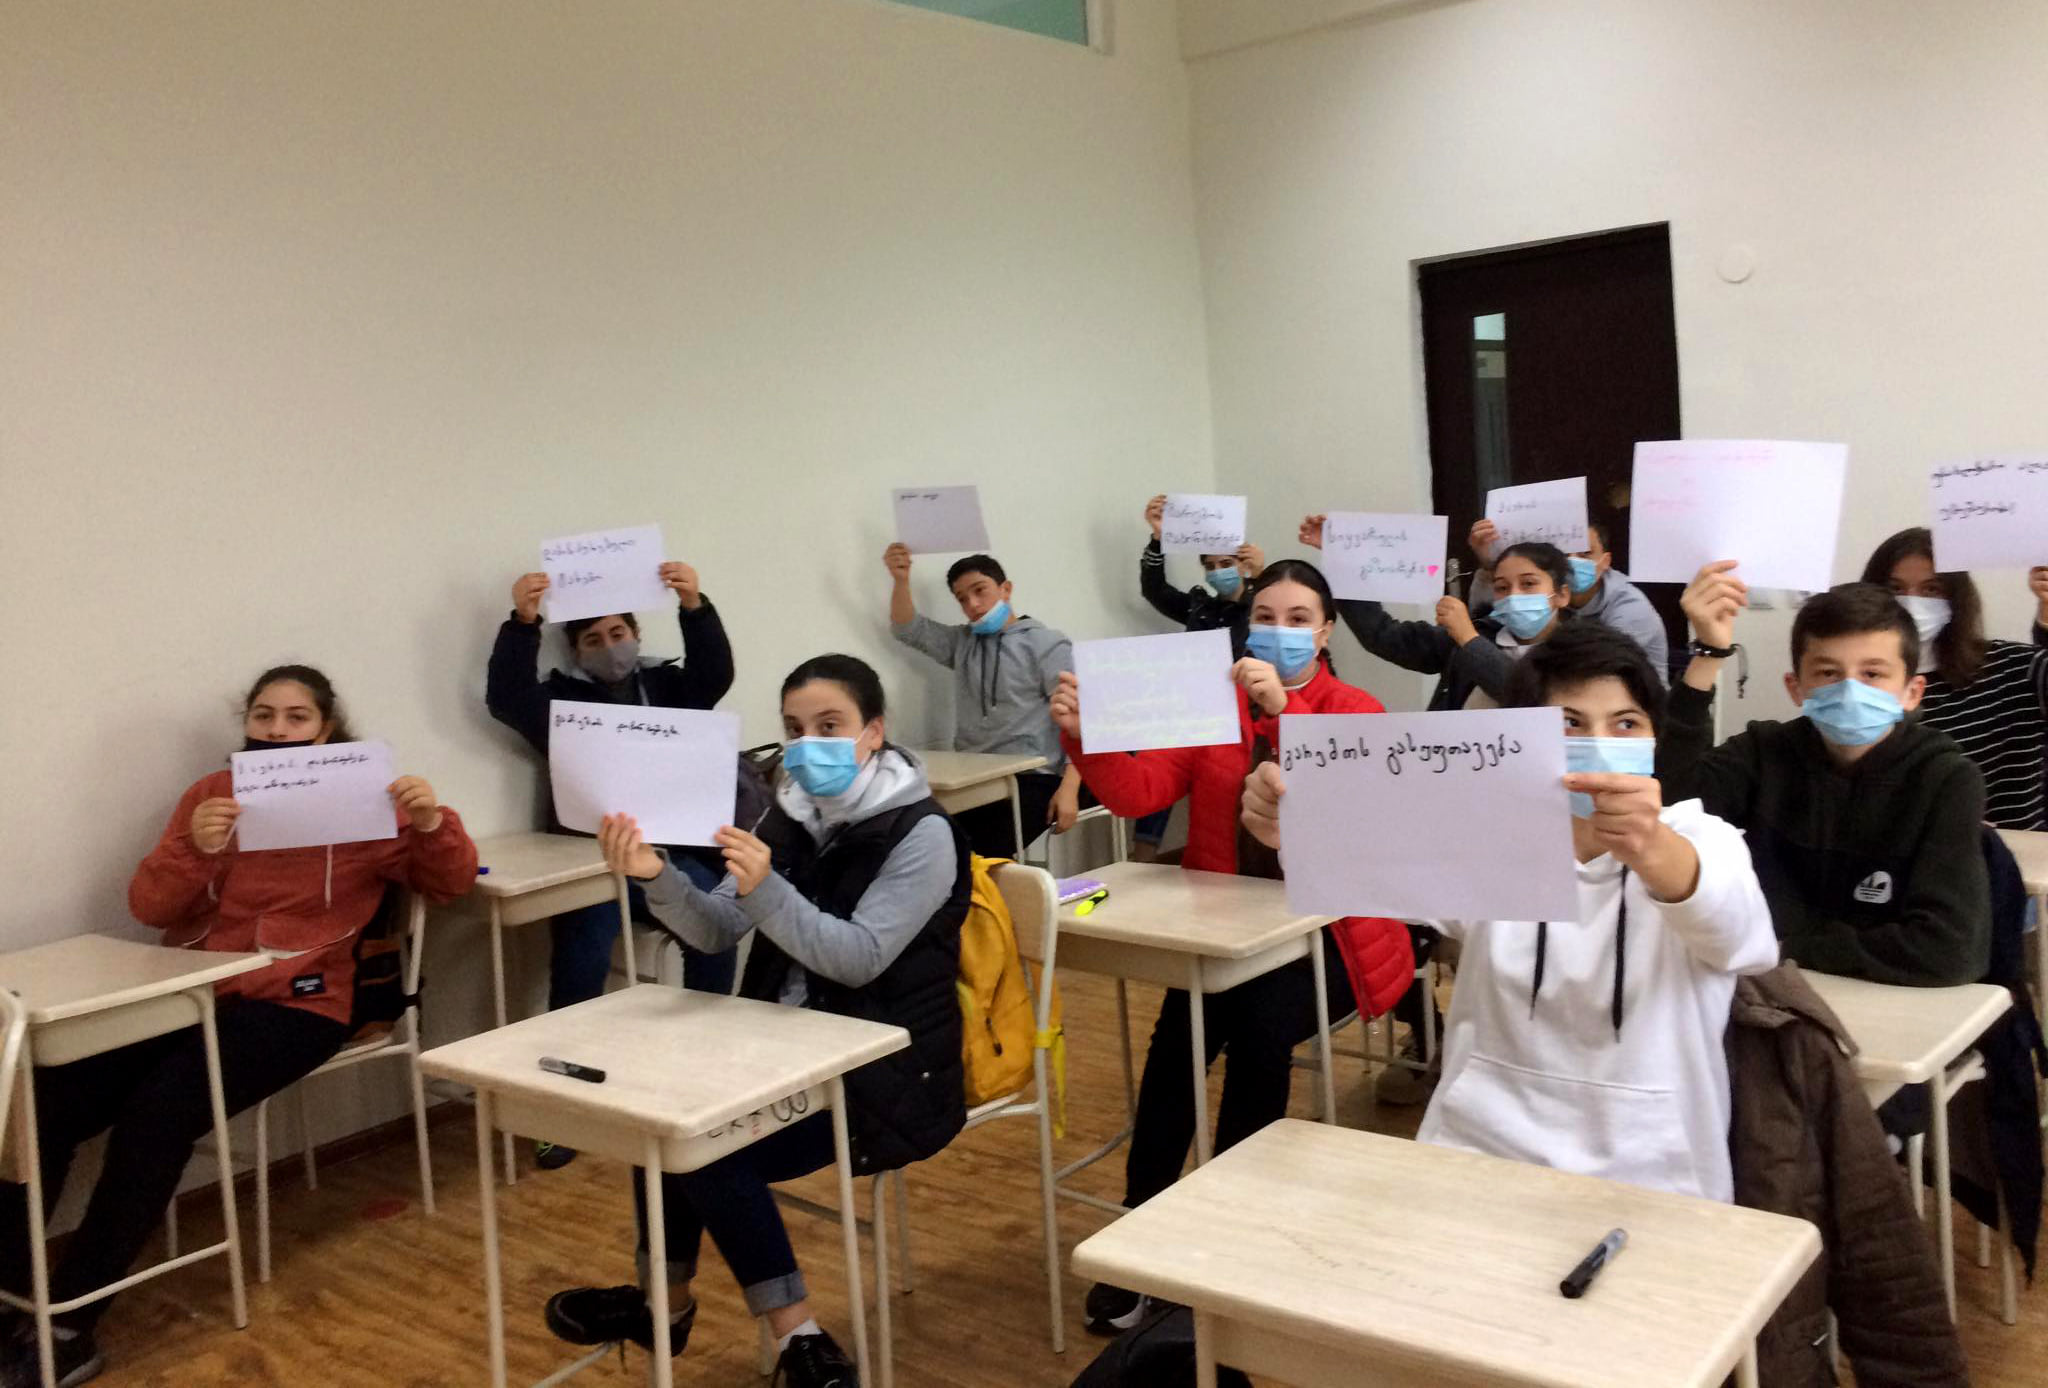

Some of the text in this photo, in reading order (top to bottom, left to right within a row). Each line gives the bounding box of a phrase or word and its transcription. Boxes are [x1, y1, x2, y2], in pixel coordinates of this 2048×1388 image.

[1327, 520, 1408, 549] სიყვარულის
[1284, 732, 1523, 775] გარემოს გასუფთავება
